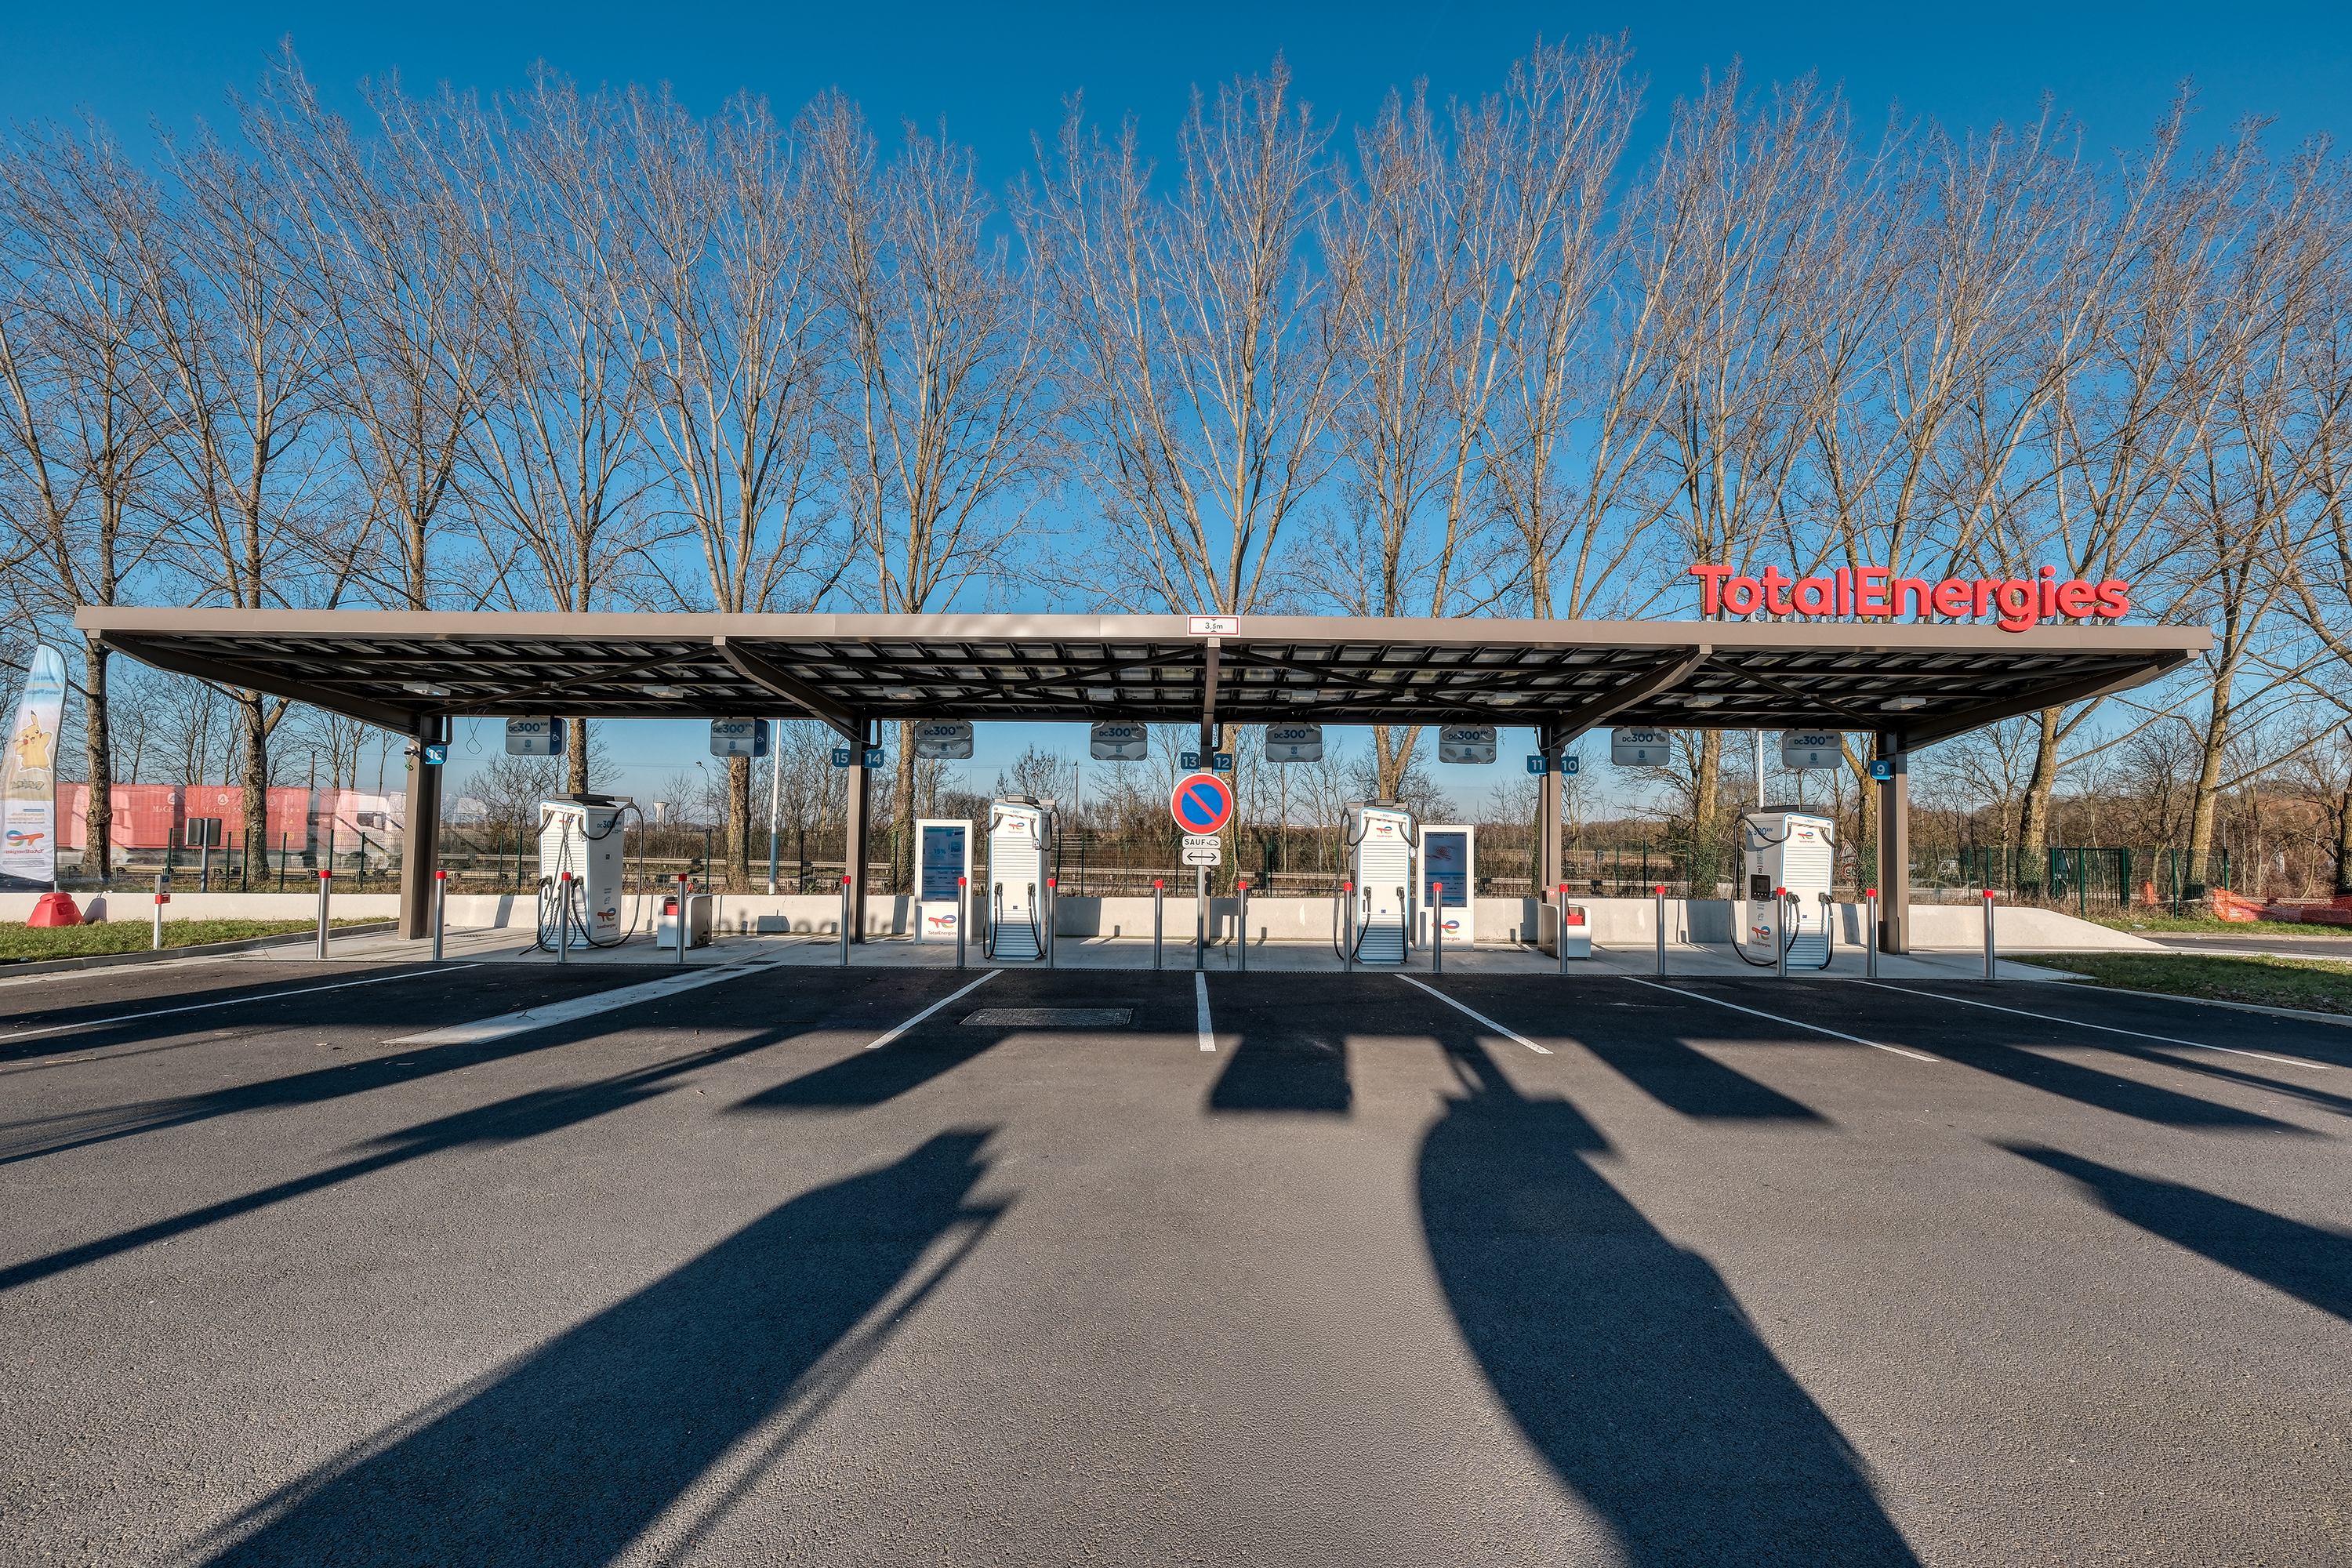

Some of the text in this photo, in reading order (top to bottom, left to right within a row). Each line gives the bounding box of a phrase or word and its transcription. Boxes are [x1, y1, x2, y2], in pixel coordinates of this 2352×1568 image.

[1689, 564, 2129, 632] TotalEnergies
[428, 750, 443, 760] 16
[834, 753, 848, 764] 15
[866, 753, 881, 764] 14
[1183, 756, 1197, 767] 13
[1216, 757, 1230, 768] 12
[1532, 759, 1543, 771] 11
[1562, 760, 1577, 771] 10
[1876, 764, 1885, 775] 9
